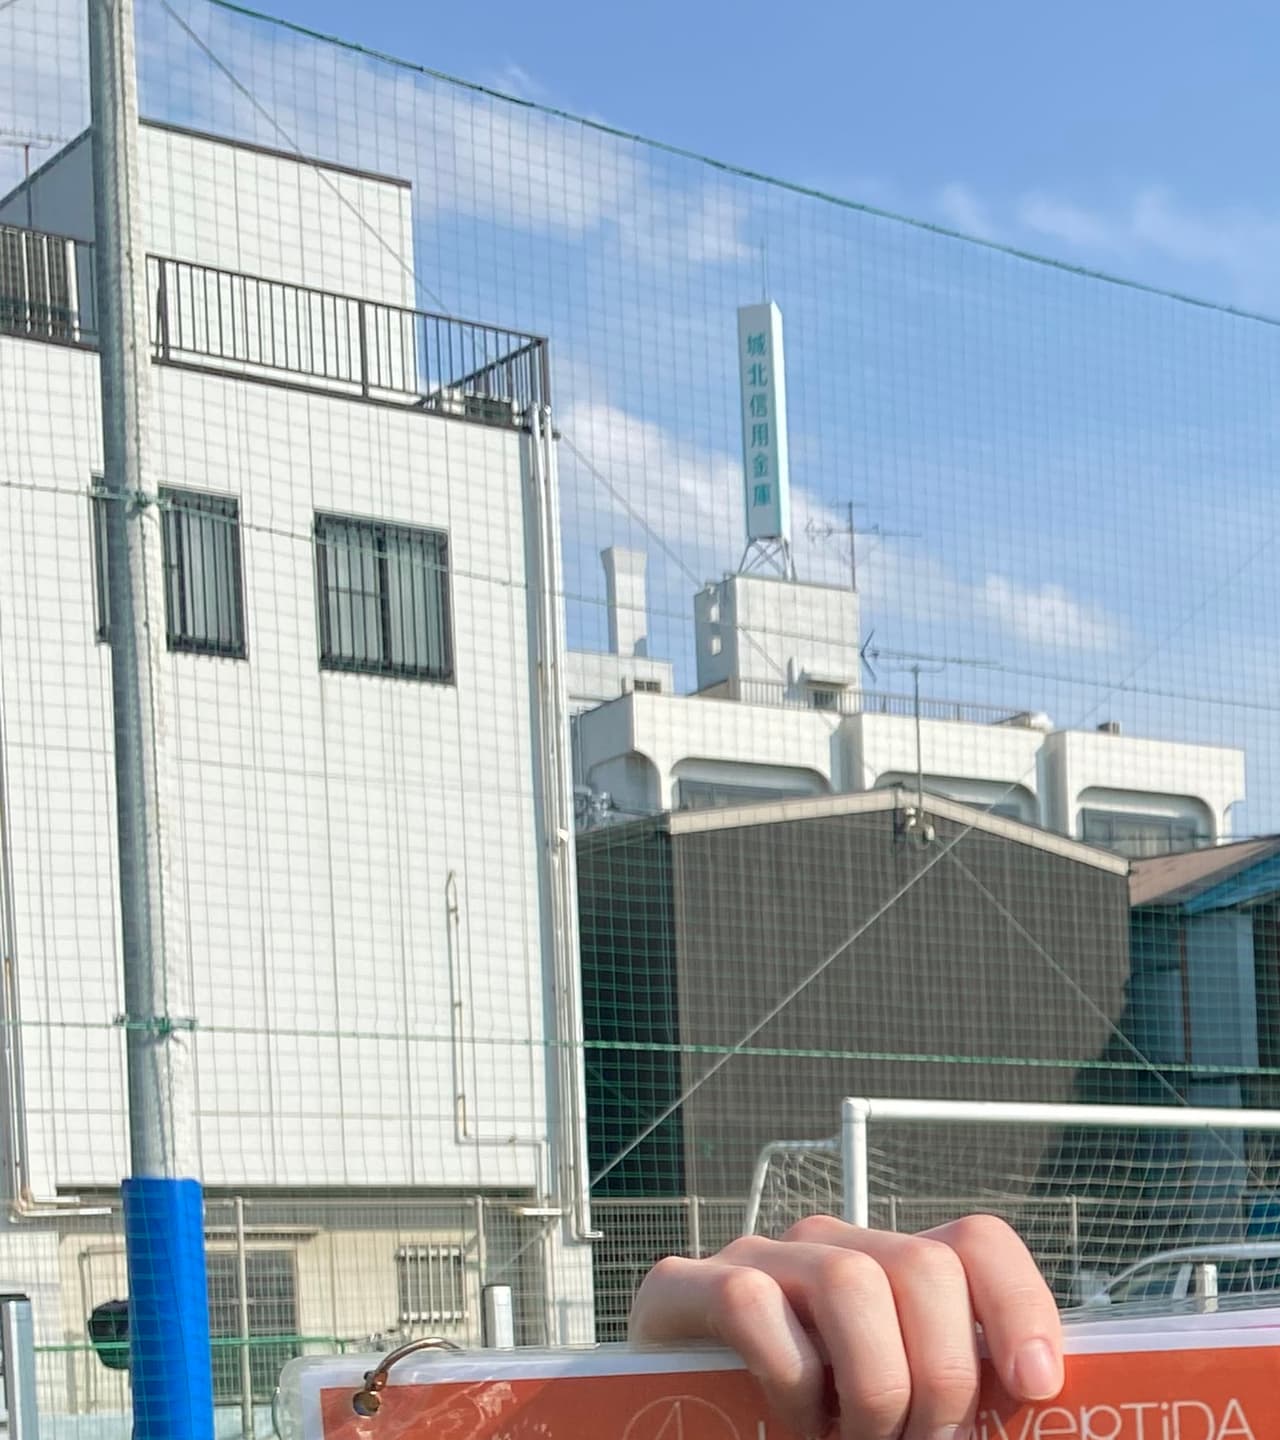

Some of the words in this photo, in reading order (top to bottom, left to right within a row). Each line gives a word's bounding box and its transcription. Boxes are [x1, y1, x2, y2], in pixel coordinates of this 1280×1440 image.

[747, 332, 771, 507] 城北信用金庫
